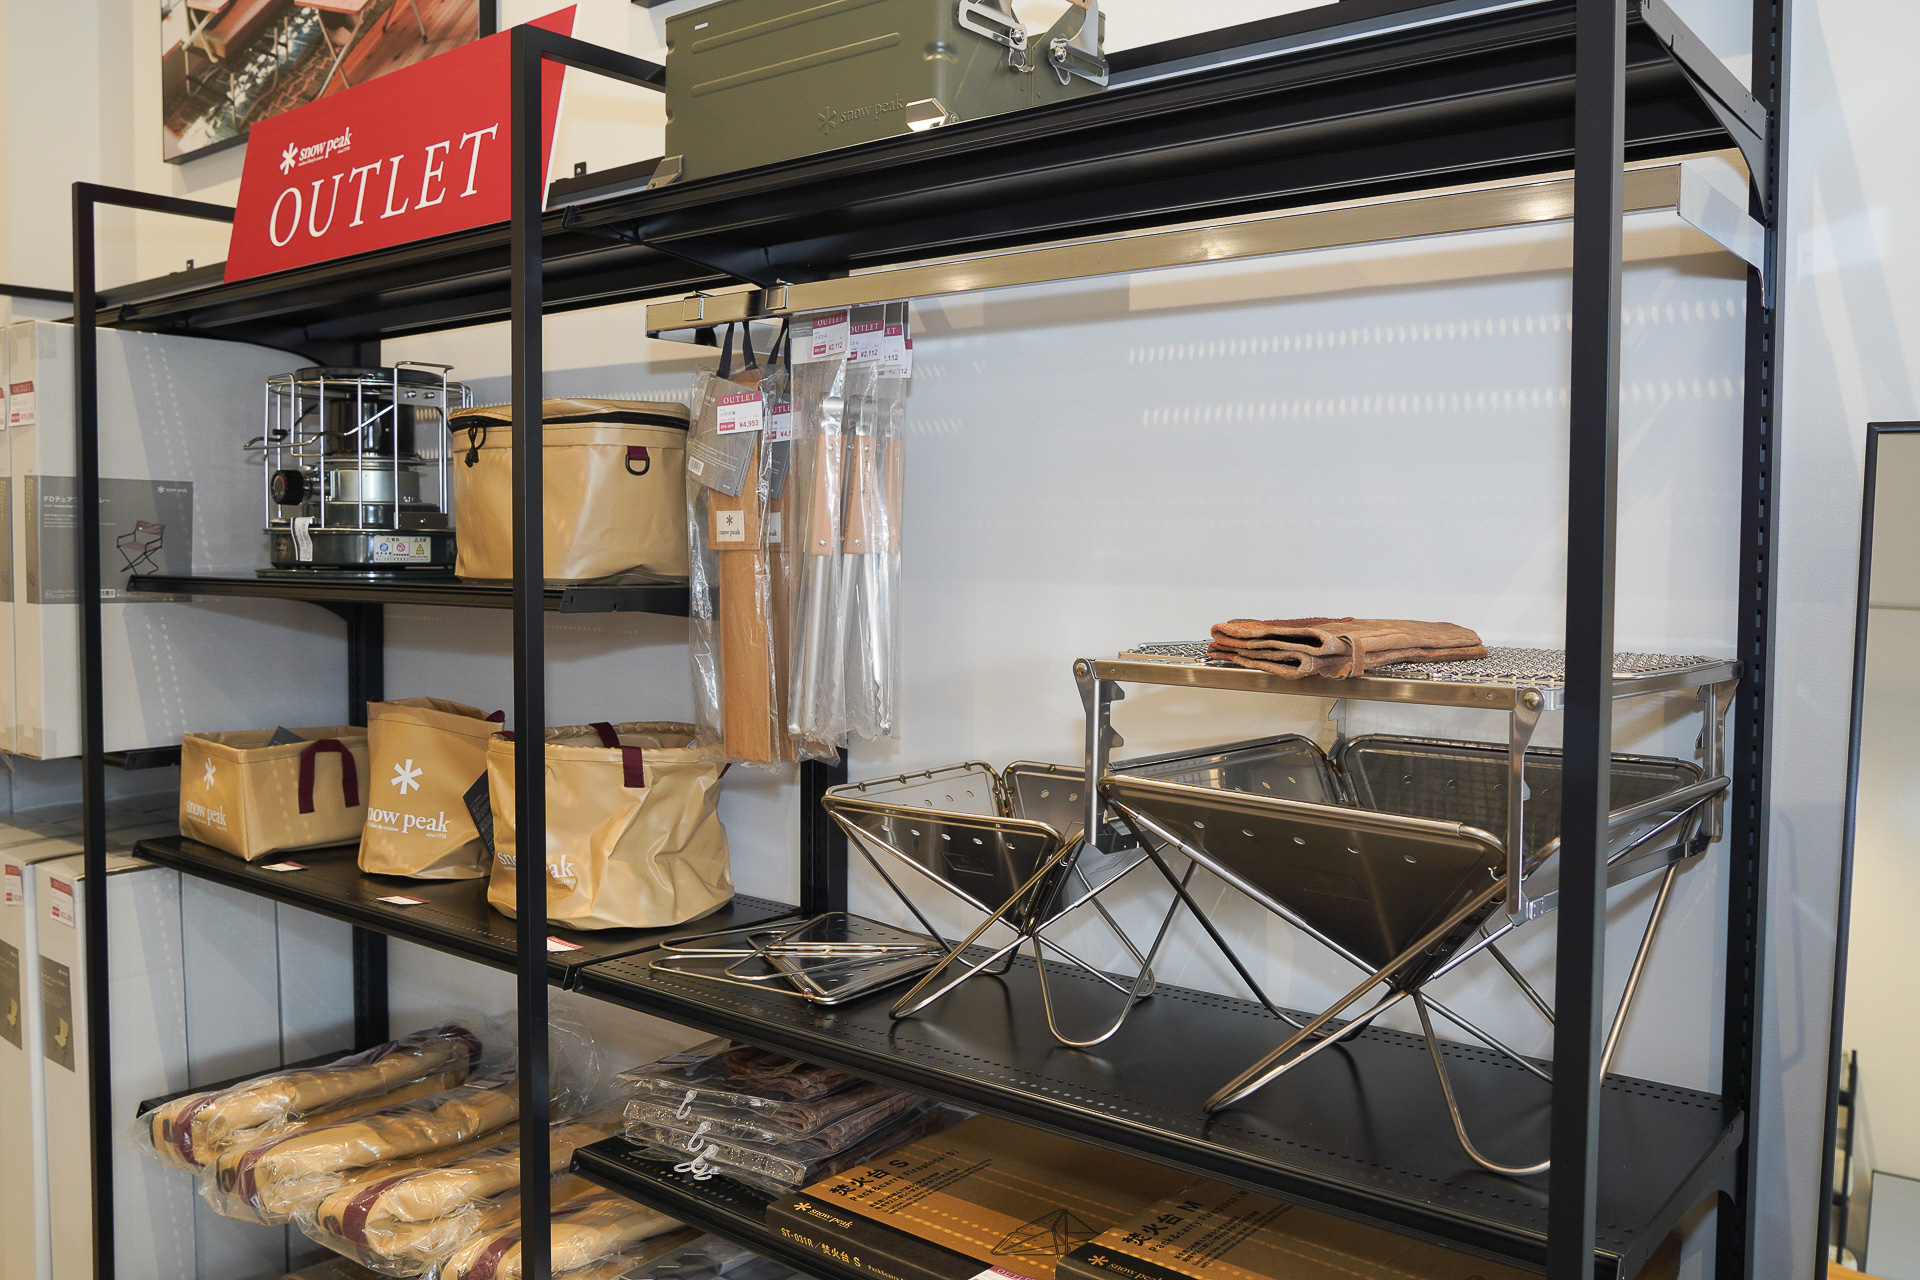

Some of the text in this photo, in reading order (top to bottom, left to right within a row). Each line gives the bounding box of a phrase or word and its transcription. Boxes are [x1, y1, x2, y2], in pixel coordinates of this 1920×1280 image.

[841, 93, 904, 123] snow peak
[298, 141, 327, 161] snow
[324, 126, 353, 159] peak
[268, 122, 499, 248] OUTLET
[817, 314, 844, 327] OUTLET
[861, 349, 878, 358] ¥2,112
[723, 393, 755, 404] OUTLET
[739, 419, 759, 429] ¥4,953
[186, 800, 207, 818] snow
[206, 805, 227, 827] peak
[368, 807, 451, 834] now peak
[548, 854, 575, 878] ak
[828, 1168, 891, 1196] 焚火台
[888, 1159, 909, 1169] S
[848, 1175, 905, 1202] Pack&carry
[809, 1208, 853, 1228] snow peak
[1121, 1200, 1205, 1247] 焚火台 M
[1148, 1220, 1204, 1253] Pack&carry
[1197, 1189, 1250, 1221] Fireplace(M
[853, 1256, 862, 1268] S
[1108, 1262, 1138, 1276] snow
